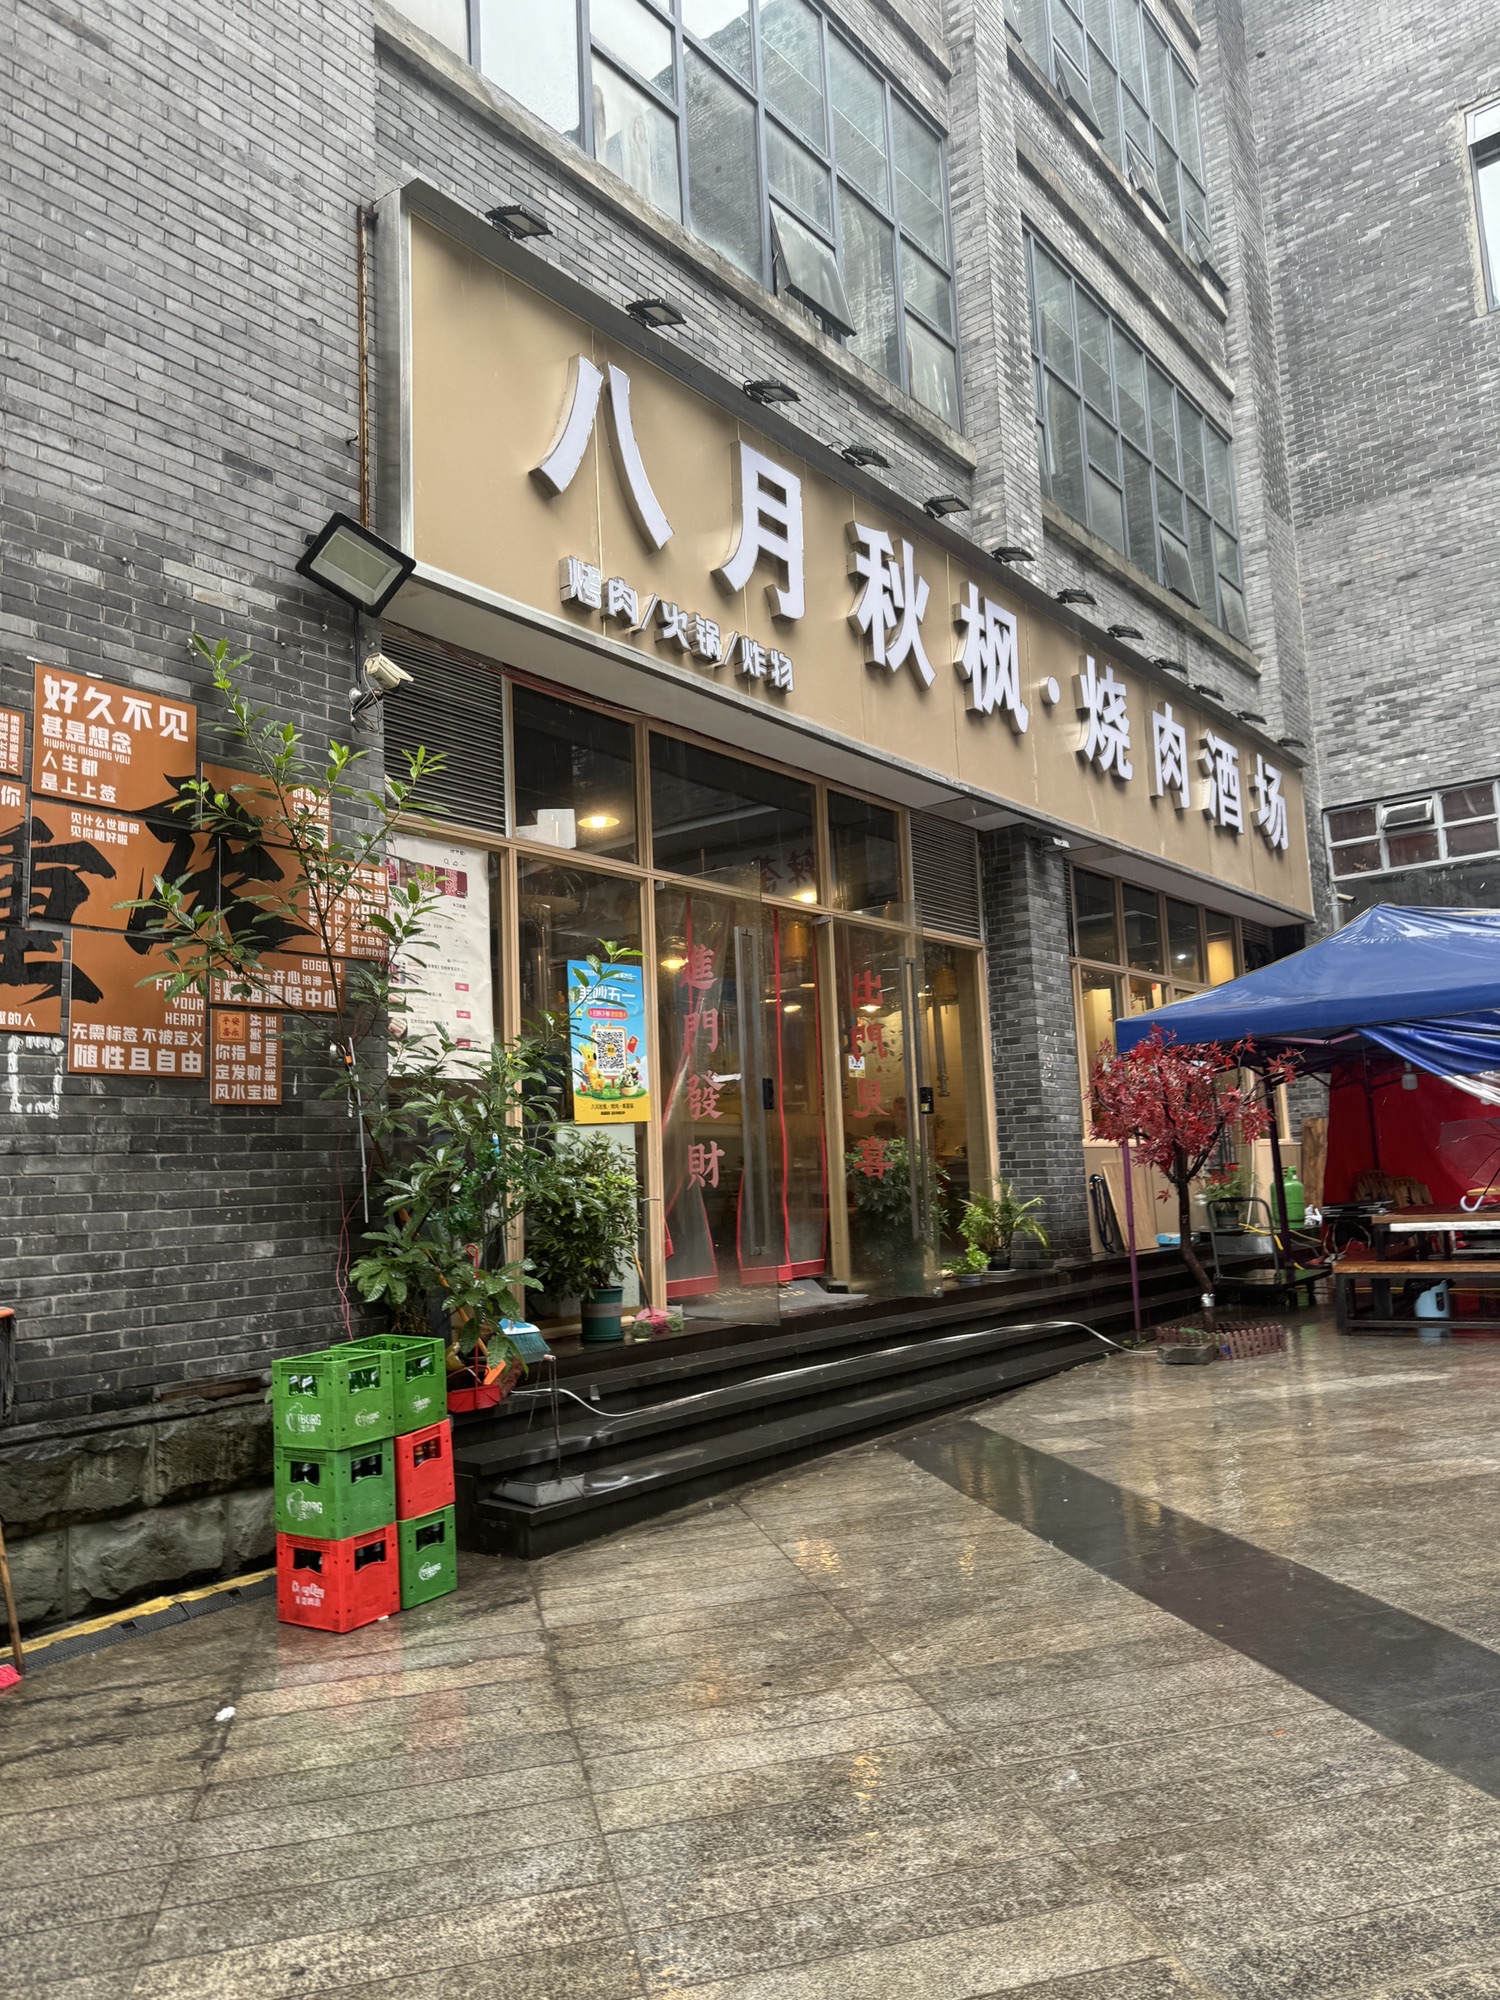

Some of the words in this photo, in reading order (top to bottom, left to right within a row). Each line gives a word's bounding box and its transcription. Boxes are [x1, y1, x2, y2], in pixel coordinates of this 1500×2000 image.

[560, 556, 794, 694] 烤肉/火锅/炸物
[43, 674, 189, 742] 好久不见
[41, 713, 132, 755] 甚是想念
[42, 750, 98, 777] 人生都
[78, 744, 113, 760] MISSING
[114, 753, 131, 765] YOU
[1, 785, 21, 807] 你
[41, 772, 116, 803] 是上上签
[71, 811, 139, 835] 见什么世面呀
[71, 825, 128, 845] 见你就好啦
[273, 970, 301, 985] 开心
[302, 959, 341, 974] GOGOO
[172, 997, 204, 1011] YOUR
[165, 1012, 204, 1027] HEART
[71, 1022, 138, 1044] 无需标签
[142, 1028, 204, 1047] 不被定义
[73, 1043, 202, 1074] 随性且自由
[215, 1044, 246, 1061] 你指
[215, 1064, 261, 1081] 定发财
[680, 944, 725, 1190] 進門發財
[850, 969, 895, 1180] 出門見喜
[215, 1083, 277, 1101] 风水宝地
